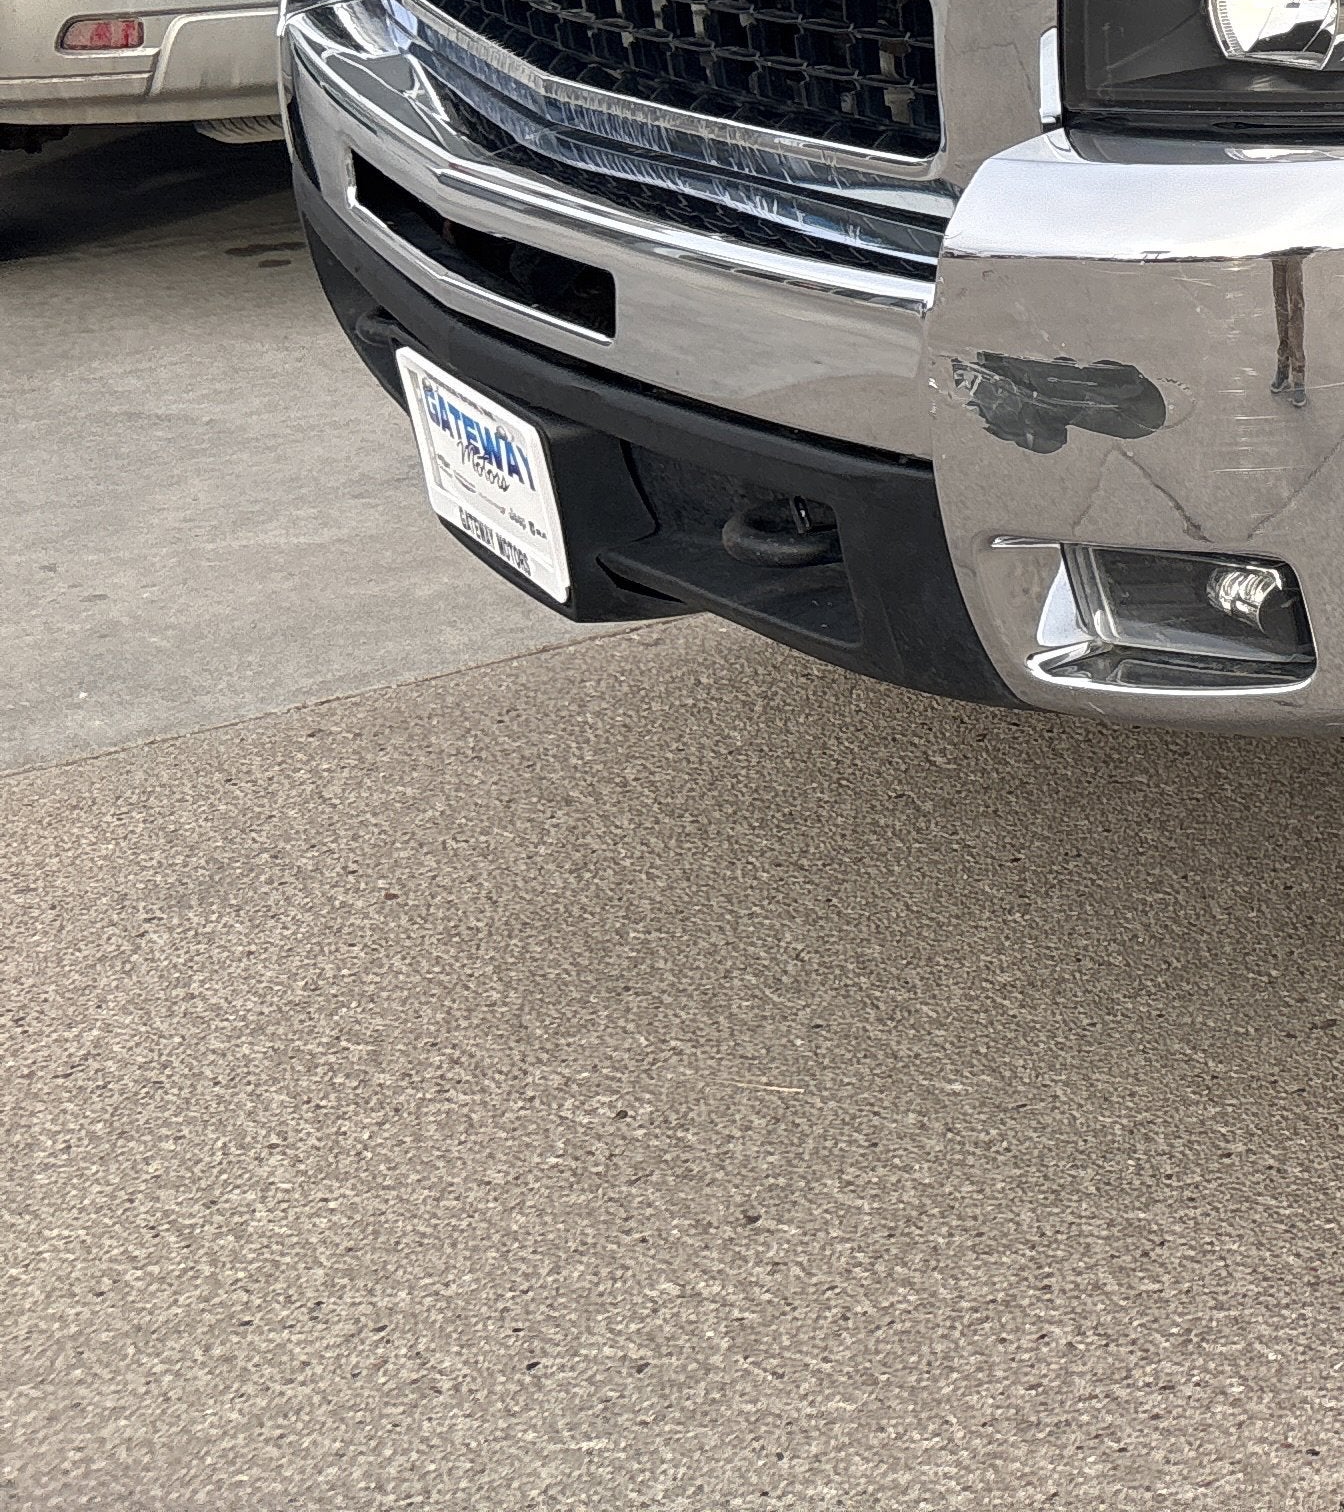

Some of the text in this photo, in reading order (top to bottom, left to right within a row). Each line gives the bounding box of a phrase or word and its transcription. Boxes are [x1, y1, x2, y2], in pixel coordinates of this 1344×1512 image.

[423, 388, 537, 492] GATEWAY
[456, 440, 511, 493] Motors
[458, 505, 496, 551] GATEWAY
